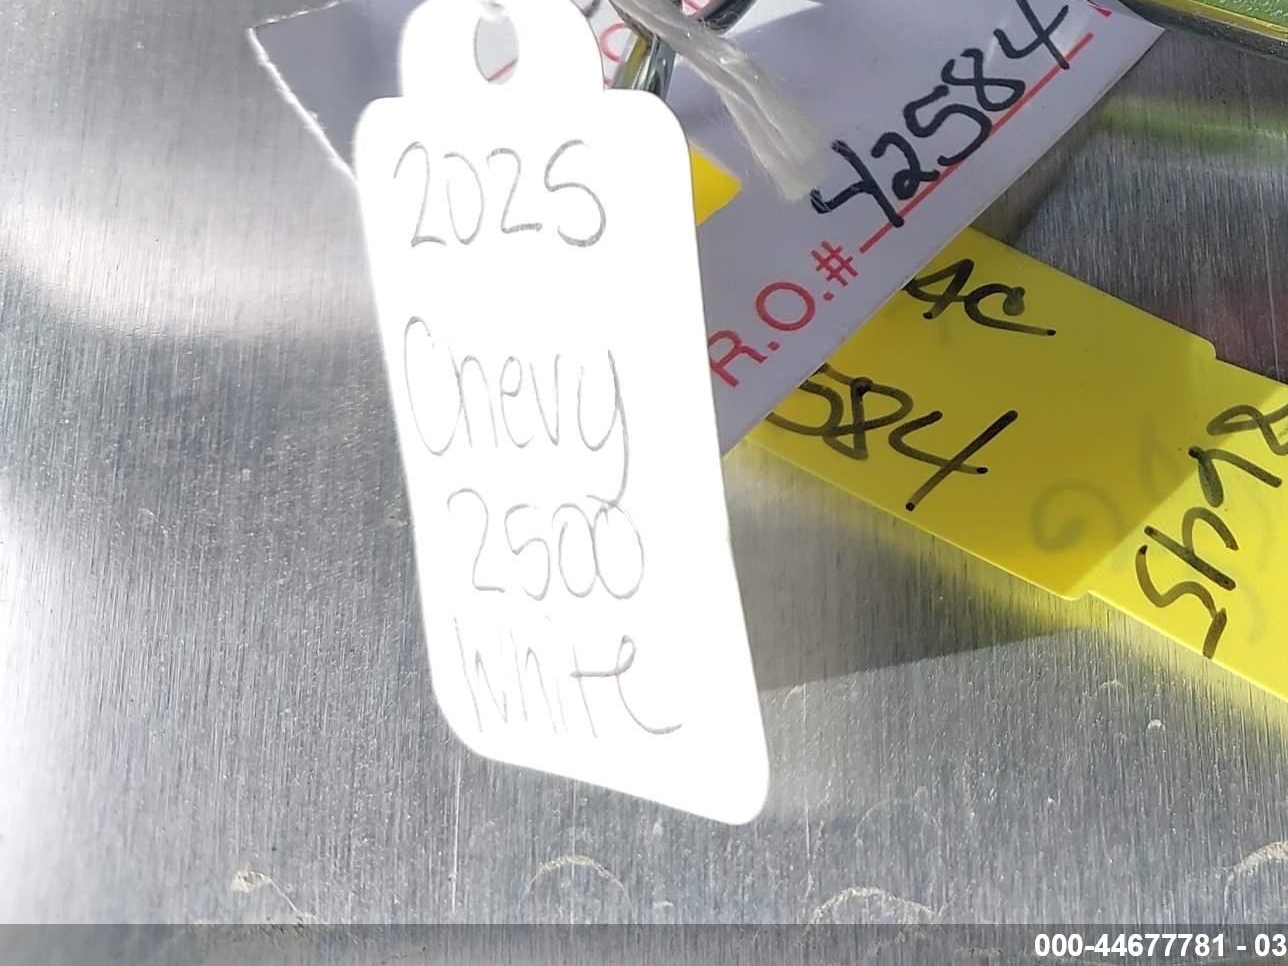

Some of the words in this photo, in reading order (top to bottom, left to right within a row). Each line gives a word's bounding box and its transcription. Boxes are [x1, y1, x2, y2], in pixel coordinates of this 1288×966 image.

[393, 139, 607, 248] 2025
[708, 240, 859, 388] R.O.#
[403, 315, 630, 513] Chevy
[446, 488, 645, 601] 2500
